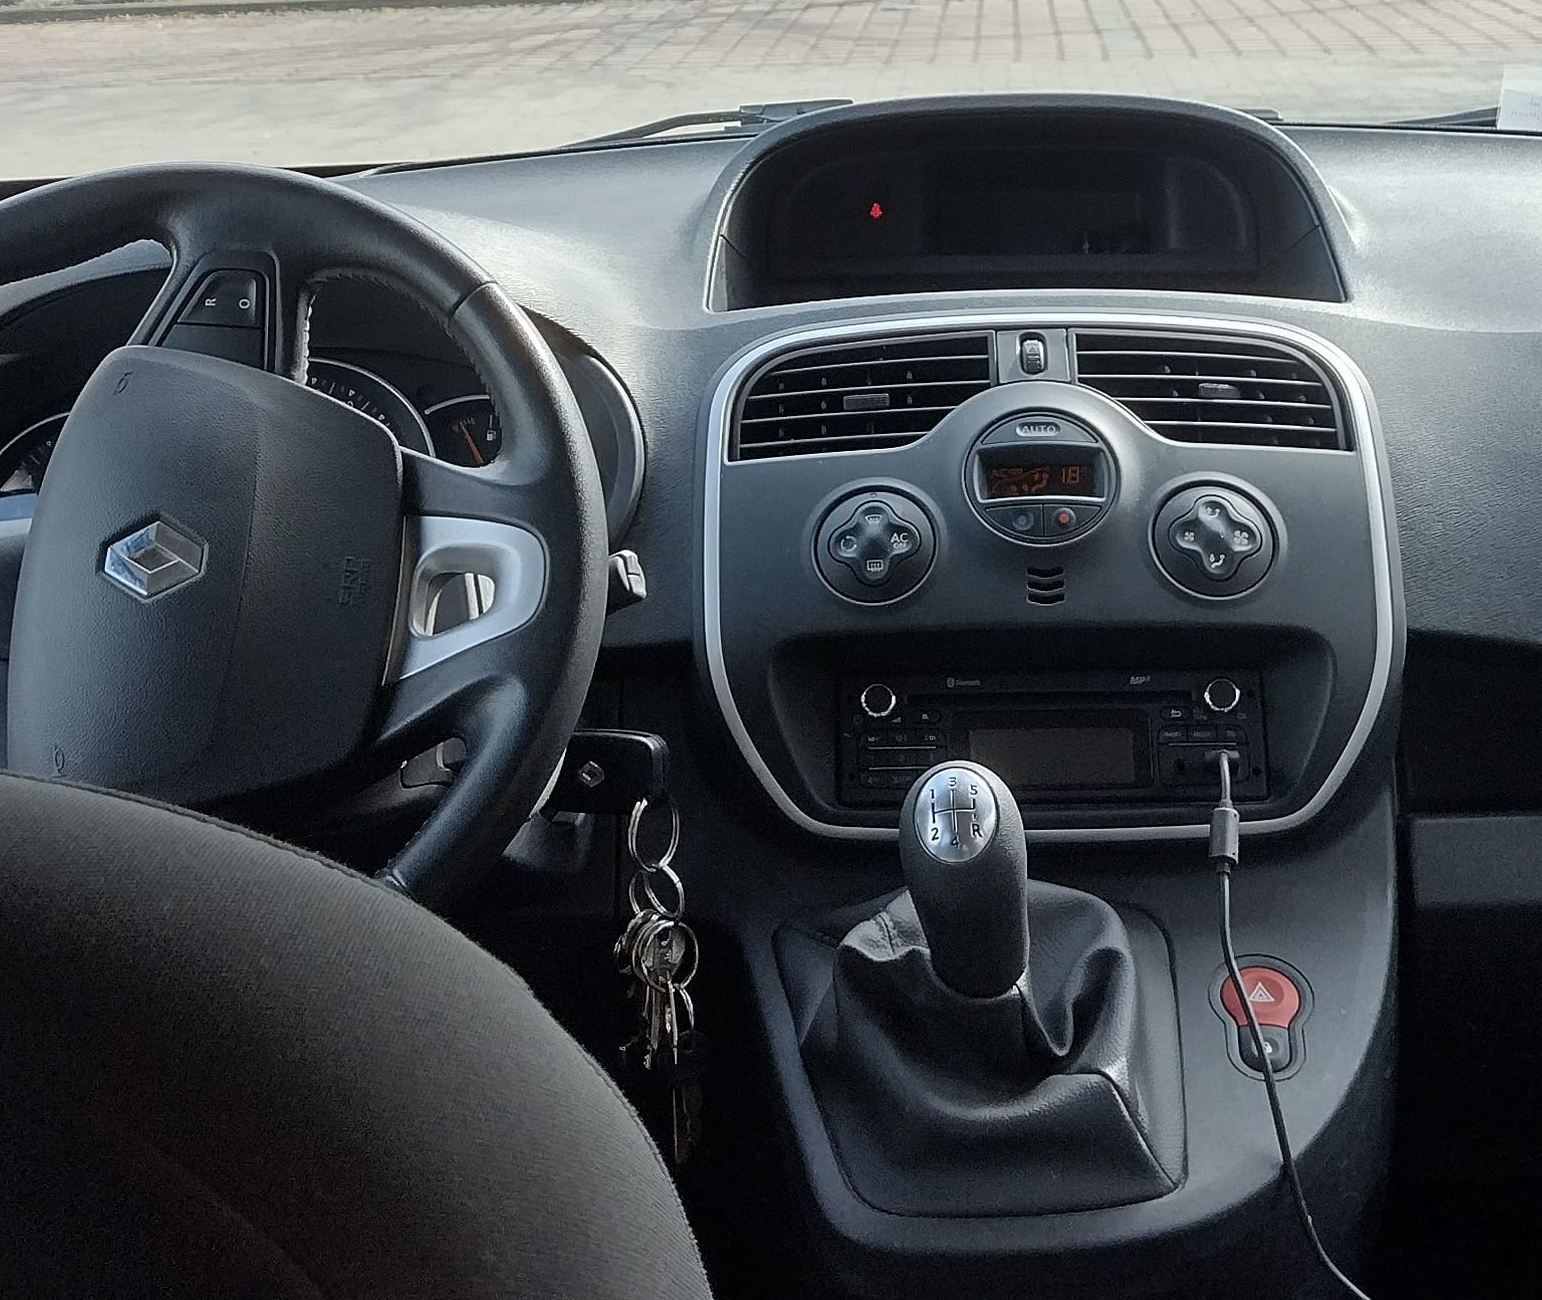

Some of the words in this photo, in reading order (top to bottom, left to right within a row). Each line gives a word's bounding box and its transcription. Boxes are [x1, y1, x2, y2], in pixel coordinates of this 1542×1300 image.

[204, 297, 217, 307] R
[1021, 424, 1057, 434] AUTO
[890, 532, 909, 543] AC
[930, 789, 935, 799] 1
[948, 776, 957, 787] 3
[969, 785, 978, 795] 5
[930, 827, 940, 842] 2
[951, 834, 960, 848] 4
[971, 823, 983, 838] R
